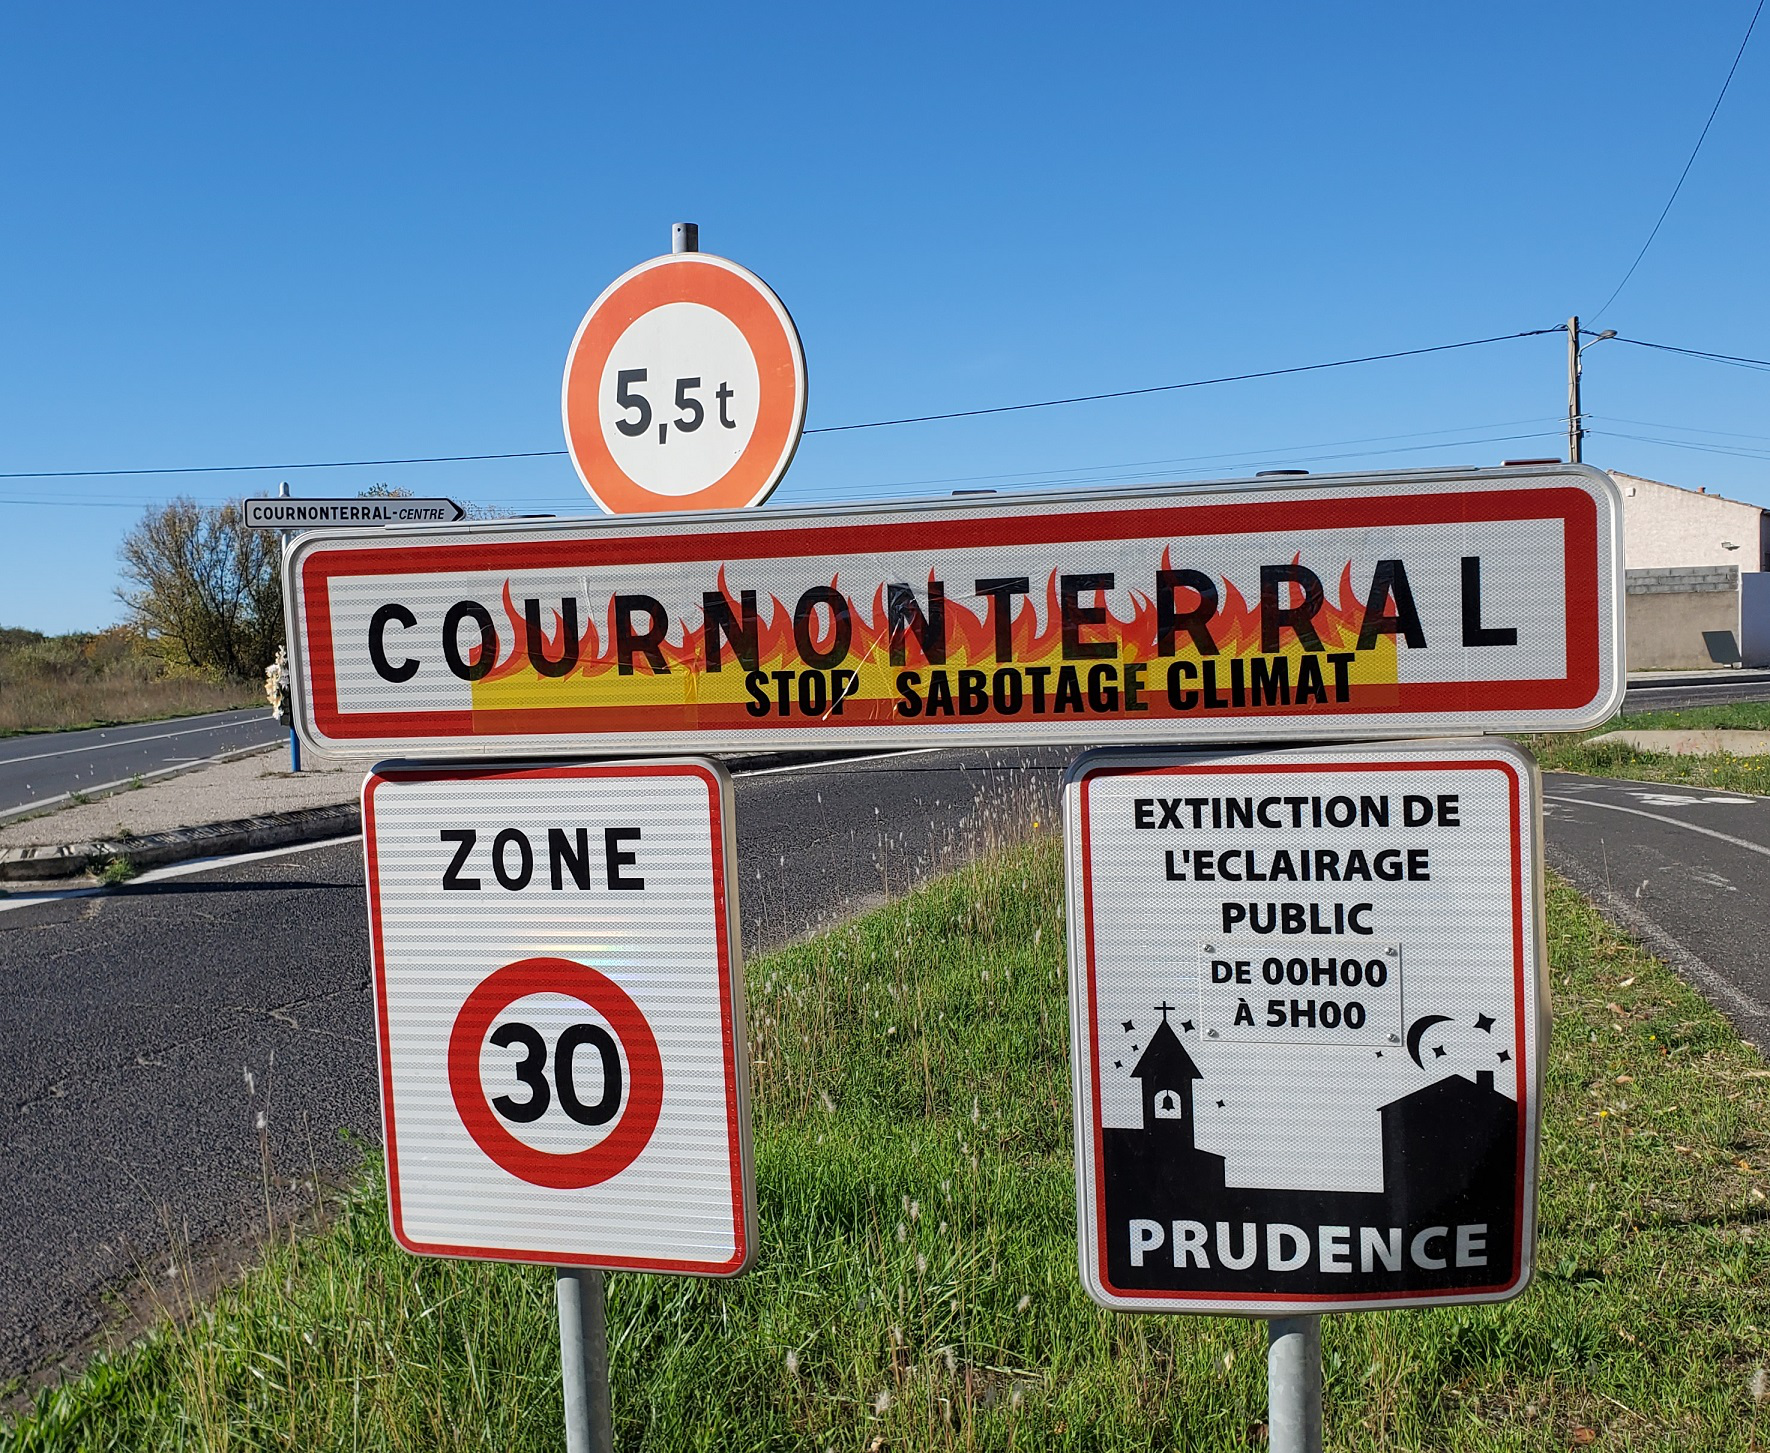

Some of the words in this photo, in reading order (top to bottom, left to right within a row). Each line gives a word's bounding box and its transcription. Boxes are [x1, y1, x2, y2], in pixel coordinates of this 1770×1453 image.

[615, 367, 704, 445] 5,5
[715, 381, 736, 429] t
[367, 556, 1518, 684] COURNONTERRAL
[745, 668, 860, 718] STOP
[896, 661, 1148, 718] SABOTAGE
[1167, 653, 1356, 711] CLIMAT
[1134, 796, 1389, 830] EXTINCTION
[1403, 794, 1461, 828] DE
[439, 827, 645, 891] ZONE
[1165, 848, 1431, 882] L'ECLAIRAGE
[1222, 902, 1374, 935] PUBLIC
[1211, 960, 1251, 985] DE
[1261, 957, 1388, 988] 00H00
[1233, 997, 1255, 1027] À
[1266, 999, 1366, 1029] 5H00
[489, 1022, 623, 1126] 30
[1129, 1218, 1488, 1273] PRUDENCE
